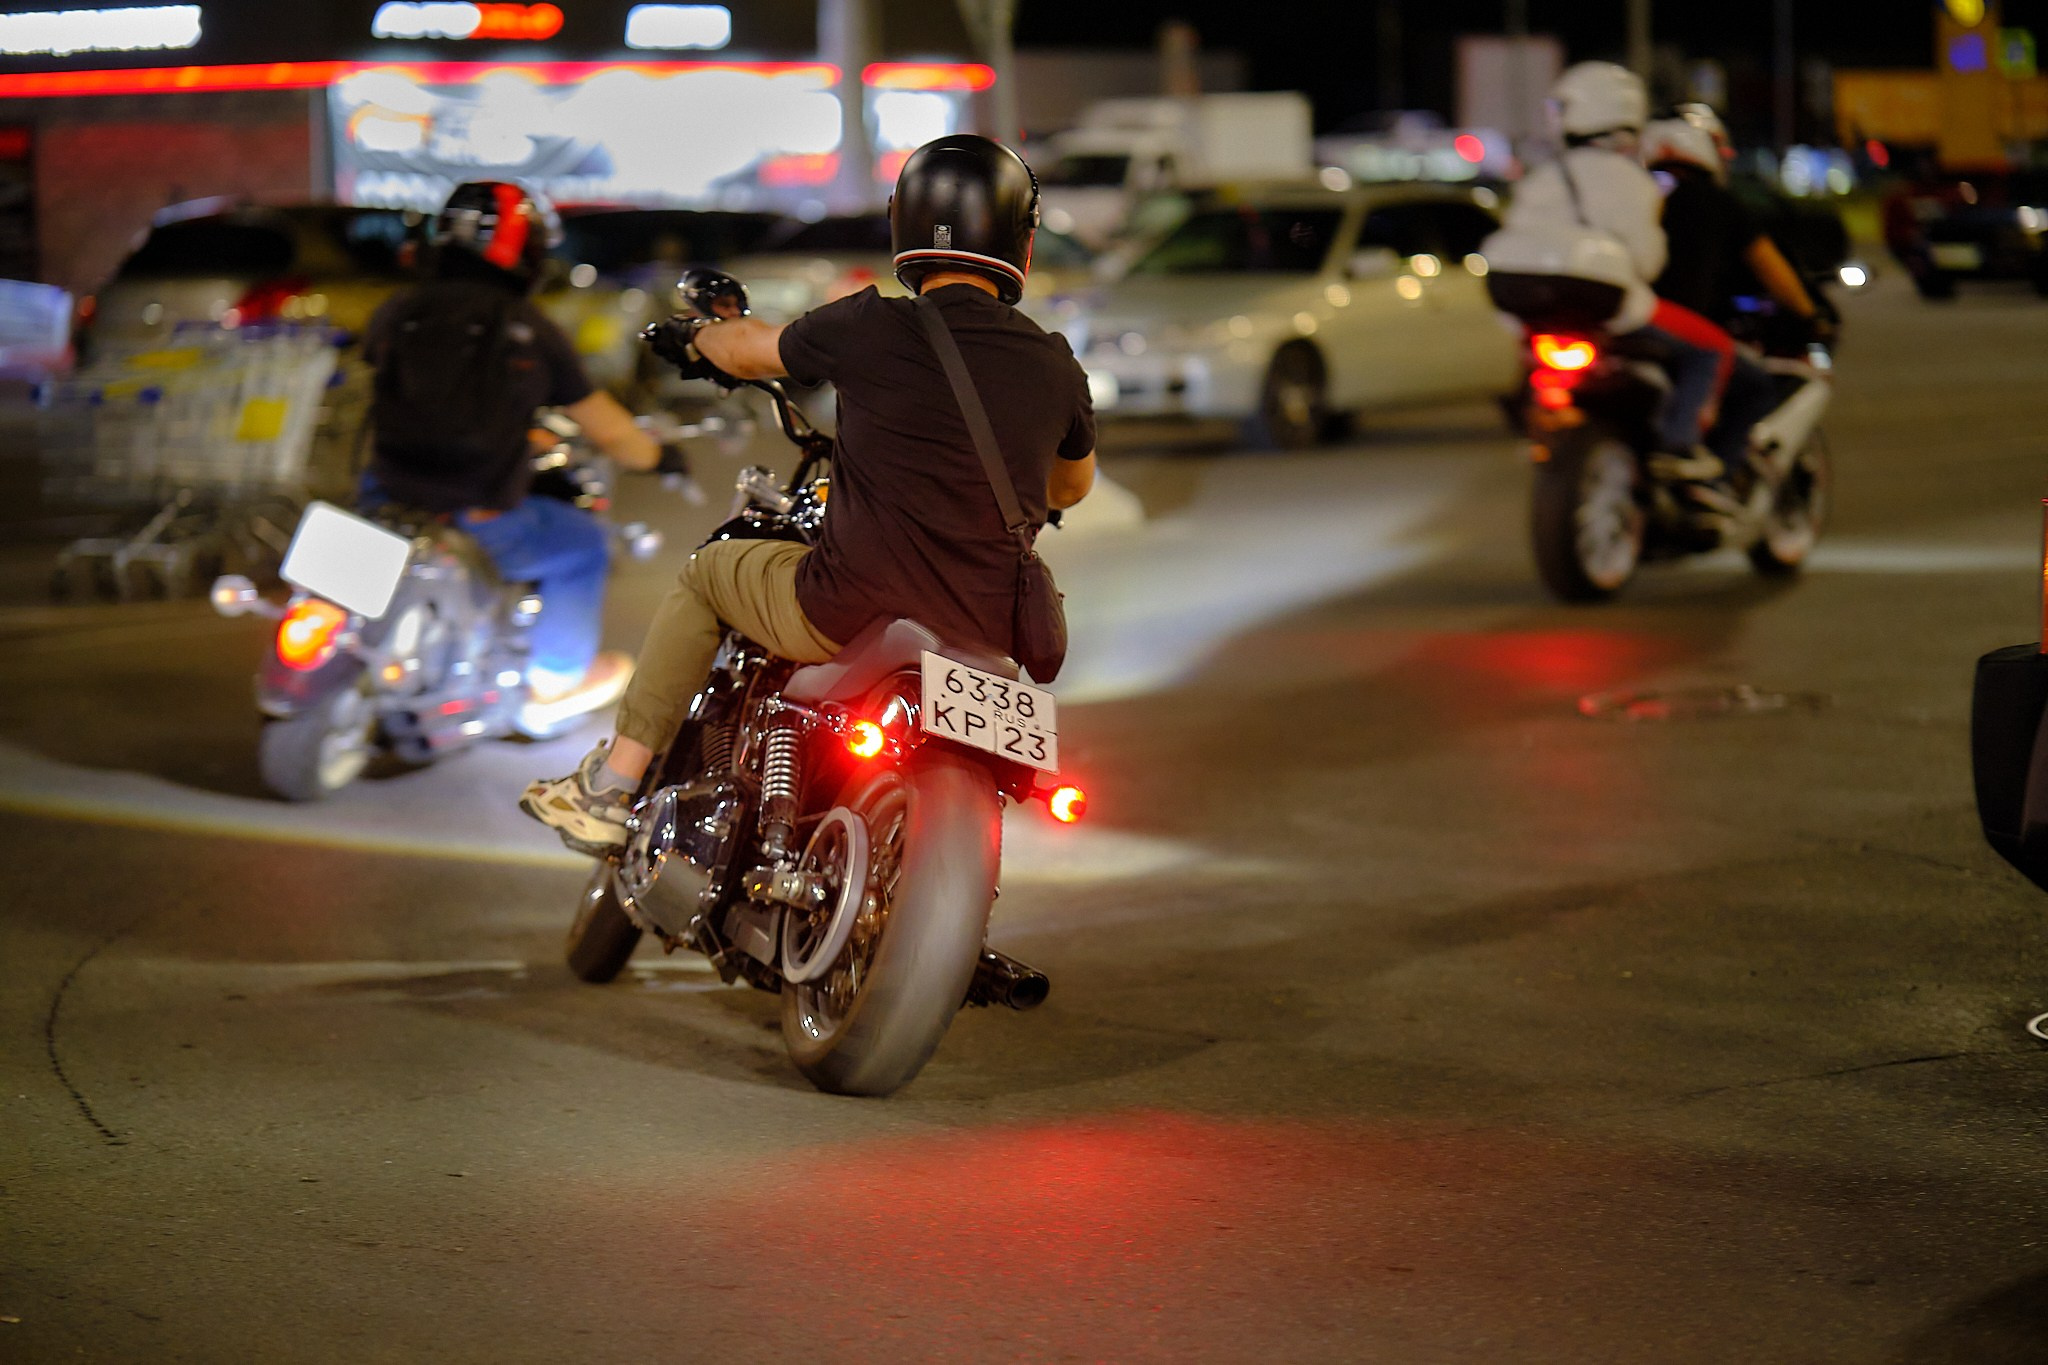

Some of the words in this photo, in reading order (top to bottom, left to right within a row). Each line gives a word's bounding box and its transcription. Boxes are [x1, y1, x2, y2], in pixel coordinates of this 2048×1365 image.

[945, 668, 1034, 719] 6338
[994, 709, 1026, 728] RUS
[1004, 726, 1046, 761] 23
